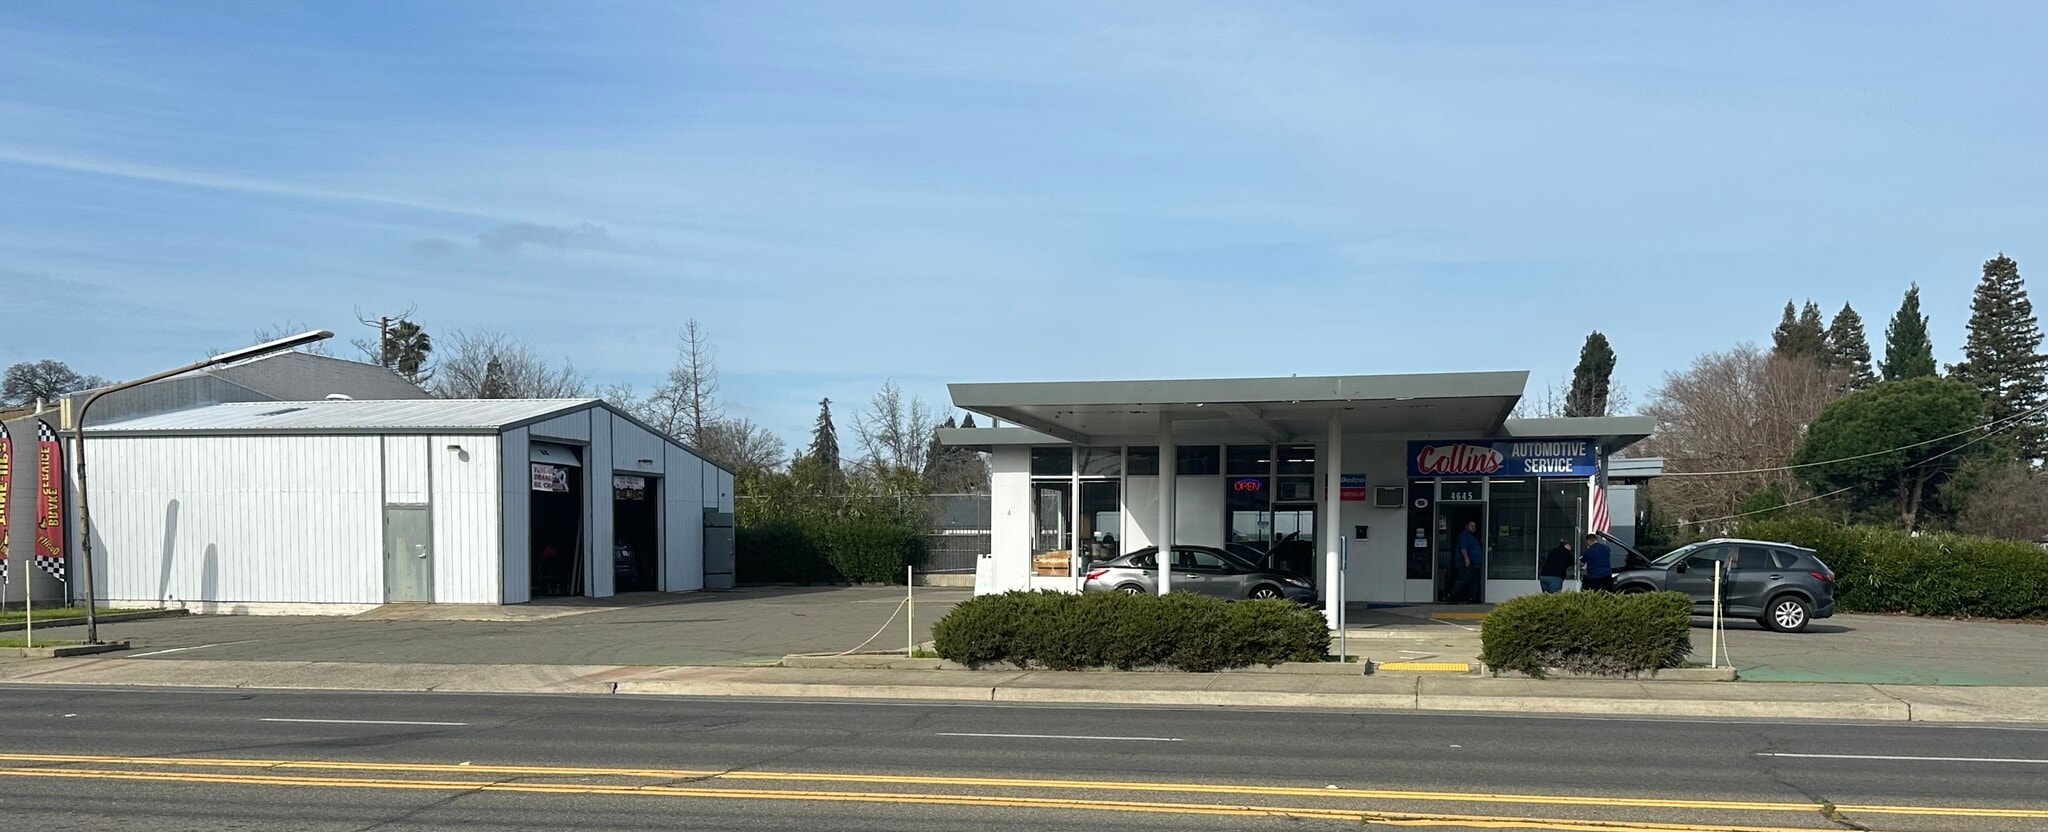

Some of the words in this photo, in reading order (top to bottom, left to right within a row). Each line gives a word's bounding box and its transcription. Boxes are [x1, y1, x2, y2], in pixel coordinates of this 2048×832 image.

[1512, 442, 1587, 457] AUTOMOTIVE
[1524, 458, 1573, 473] SERVICE
[1234, 481, 1260, 491] OPEN
[1450, 491, 1473, 501] 4645
